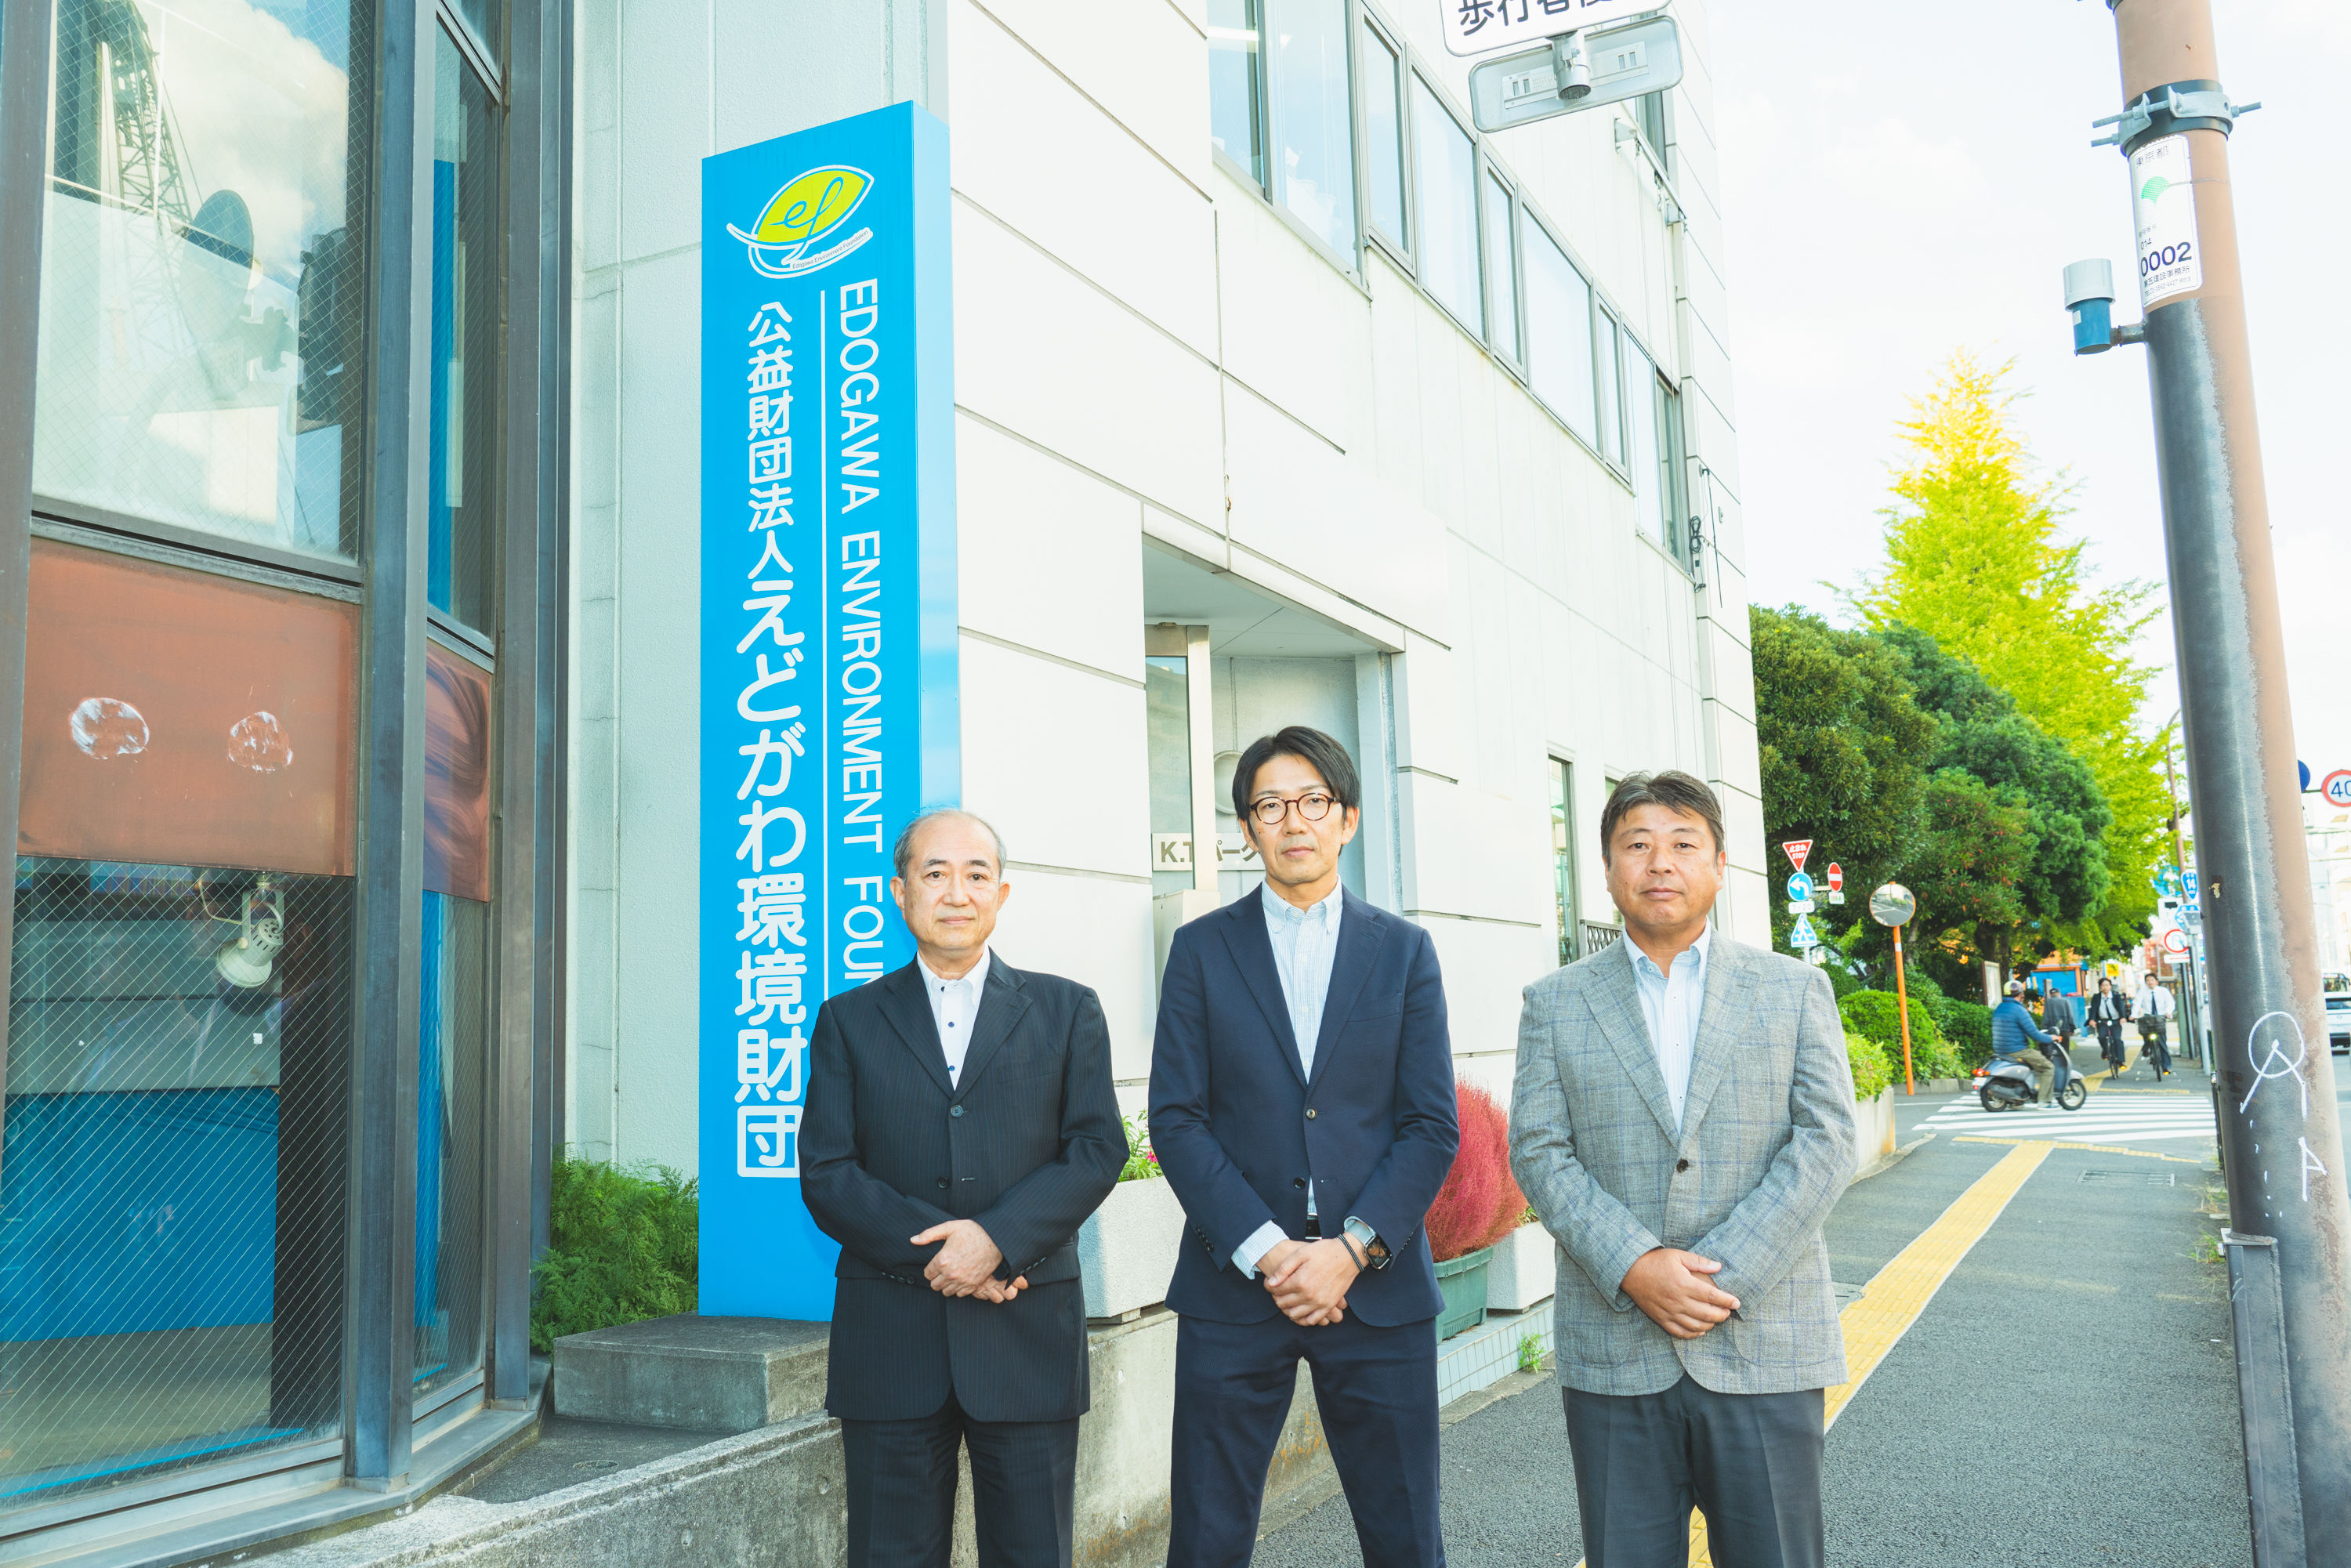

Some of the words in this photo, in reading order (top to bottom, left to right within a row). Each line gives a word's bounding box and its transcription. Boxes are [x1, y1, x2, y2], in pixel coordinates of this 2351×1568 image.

[1458, 0, 1612, 36] 歩行
[2136, 146, 2168, 168] 東京都
[792, 259, 813, 269] Edogawa
[814, 246, 842, 263] Environment
[842, 230, 868, 248] Foundation
[2140, 241, 2192, 277] 0002
[840, 278, 879, 514] EDOGAWA
[842, 531, 882, 853] ENVIRONMENT
[735, 302, 806, 1178] 公益財団法人えどがわ環境財団
[2186, 878, 2196, 889] 14
